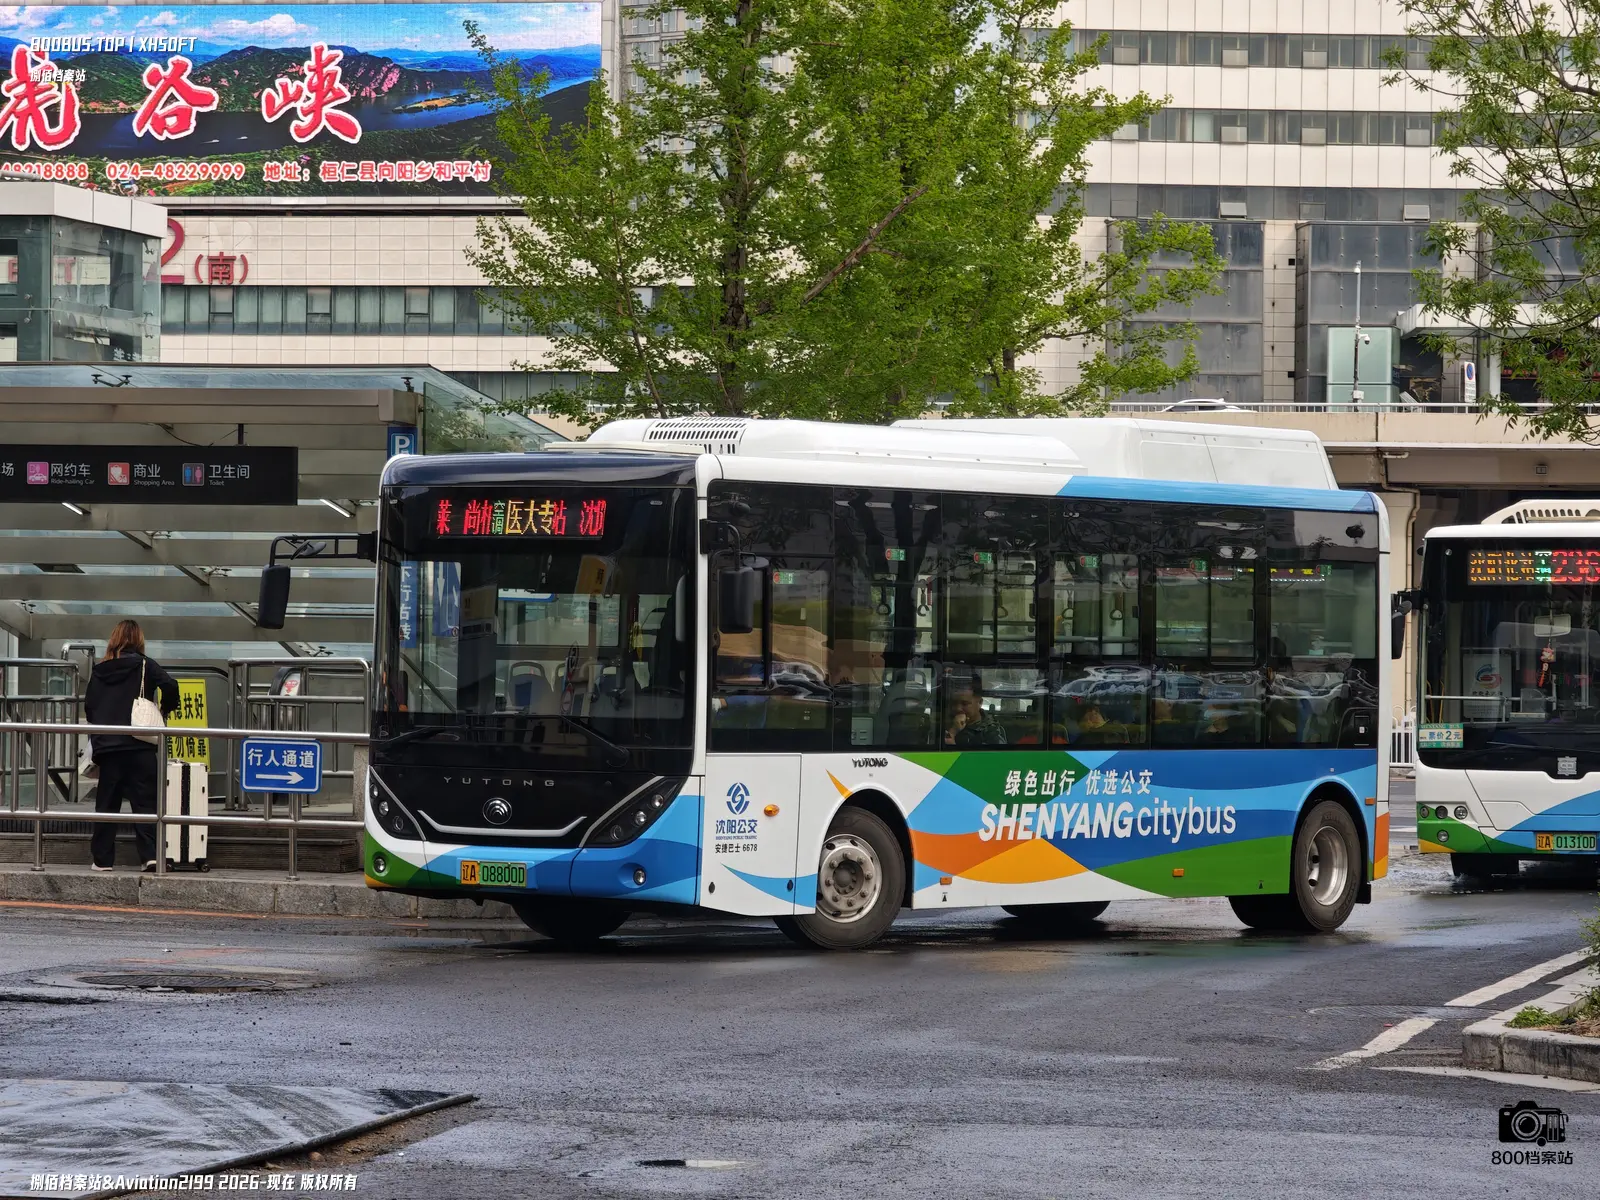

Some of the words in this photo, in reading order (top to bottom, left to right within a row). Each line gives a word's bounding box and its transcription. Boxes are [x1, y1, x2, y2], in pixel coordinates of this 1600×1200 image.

[106, 163, 246, 181] 024-48229999
[0, 462, 15, 477] 场
[50, 463, 91, 477] 网约车
[133, 464, 161, 478] 商业
[208, 465, 250, 479] 卫生间
[247, 747, 315, 769] 行人通道
[851, 757, 888, 768] YUTONG
[443, 776, 555, 787] YUTONG
[1003, 769, 1076, 796] 绿色出行
[1085, 769, 1154, 796] 优选公交
[715, 819, 758, 834] 沈阳公交
[978, 801, 1135, 841] SHENYANG
[1136, 797, 1237, 843] citybus
[714, 843, 741, 853] 安捷巴士
[742, 843, 758, 852] 6678
